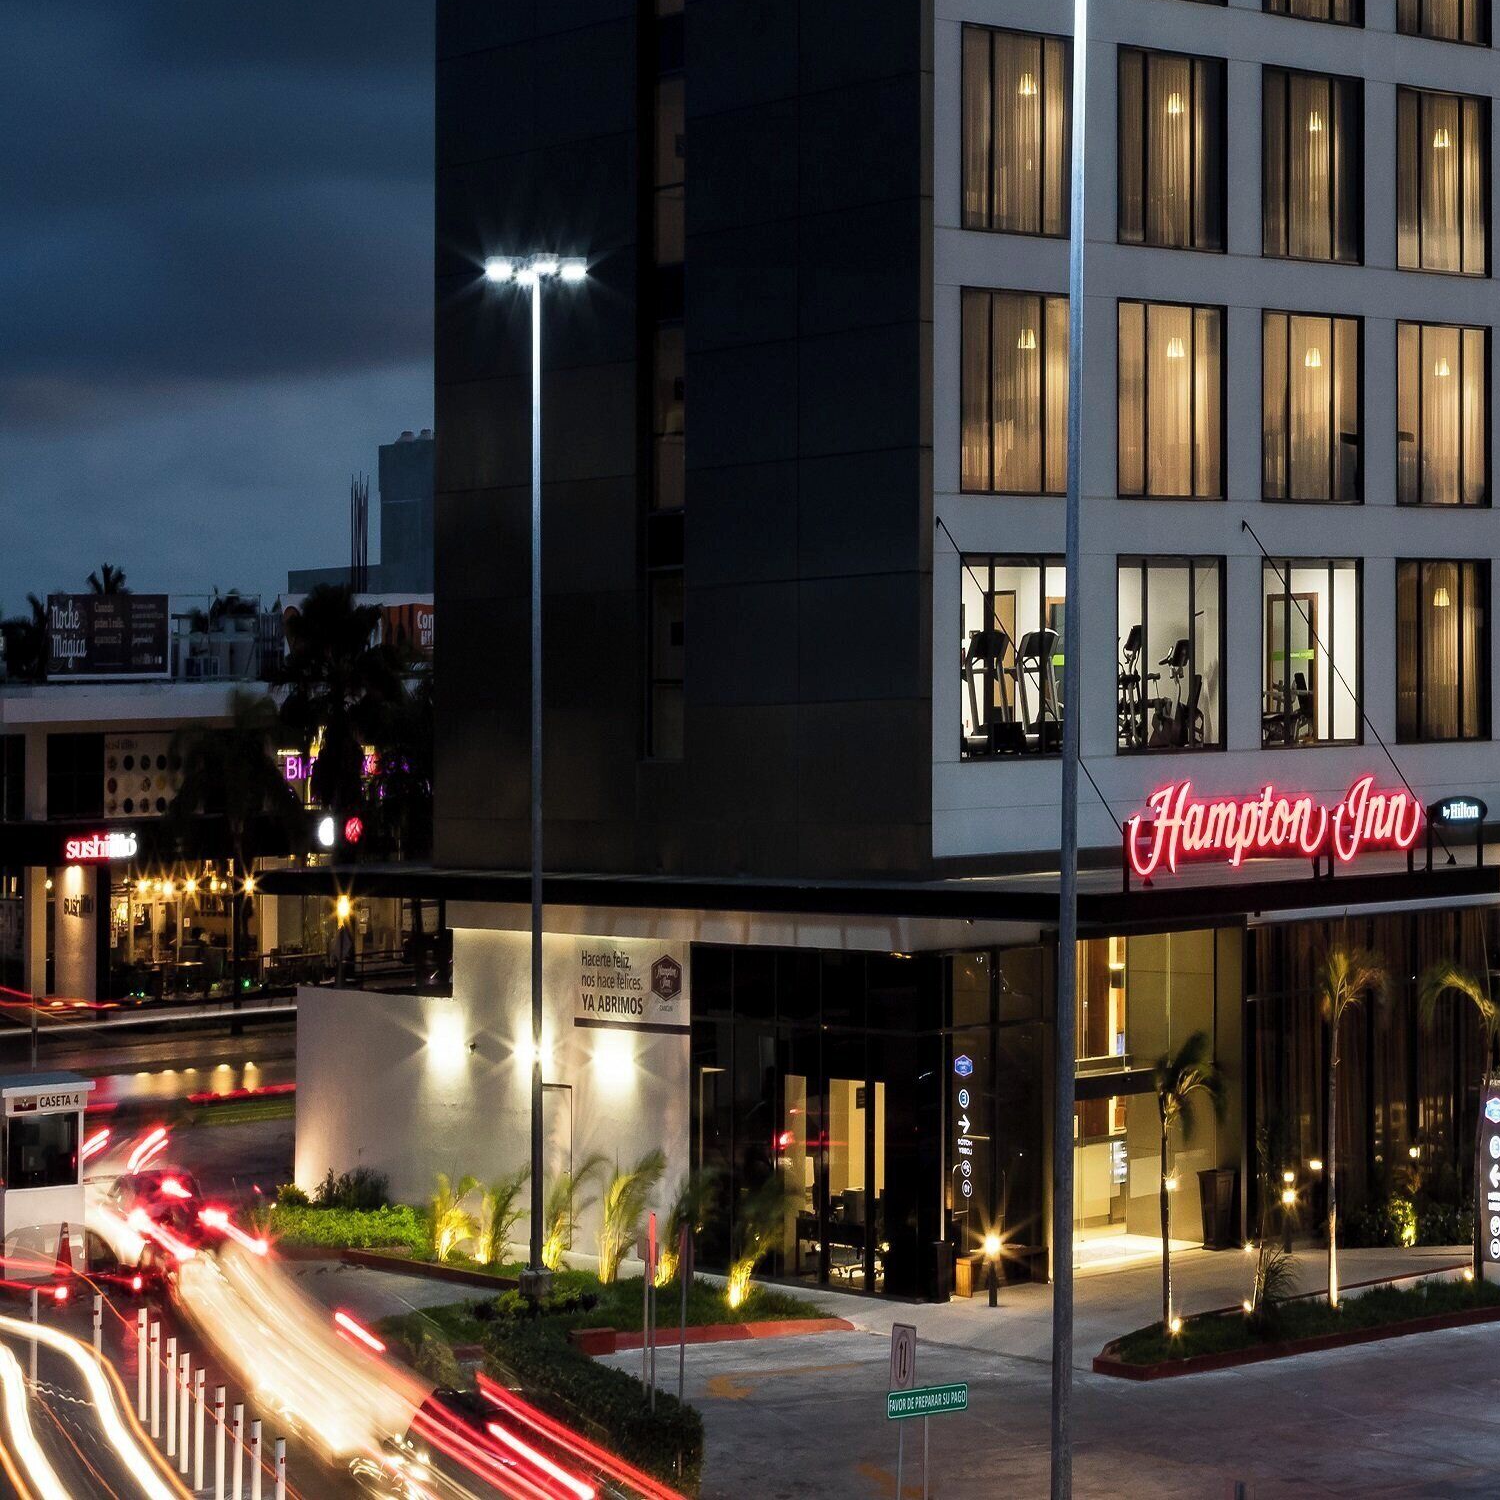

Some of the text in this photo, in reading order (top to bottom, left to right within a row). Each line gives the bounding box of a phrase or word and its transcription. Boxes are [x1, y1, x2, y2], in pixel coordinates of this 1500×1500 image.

[51, 599, 81, 630] Noche
[1442, 802, 1479, 820] by Hilton
[1129, 776, 1421, 876] Hampton Inn
[581, 950, 611, 968] Hacerte
[581, 974, 595, 988] nos
[597, 972, 615, 990] hace
[582, 993, 643, 1015] YA ABRIMOS
[40, 1094, 79, 1108] CASETA 4
[889, 1390, 966, 1412] FAVOR DE PREPARAR SU PAGO
